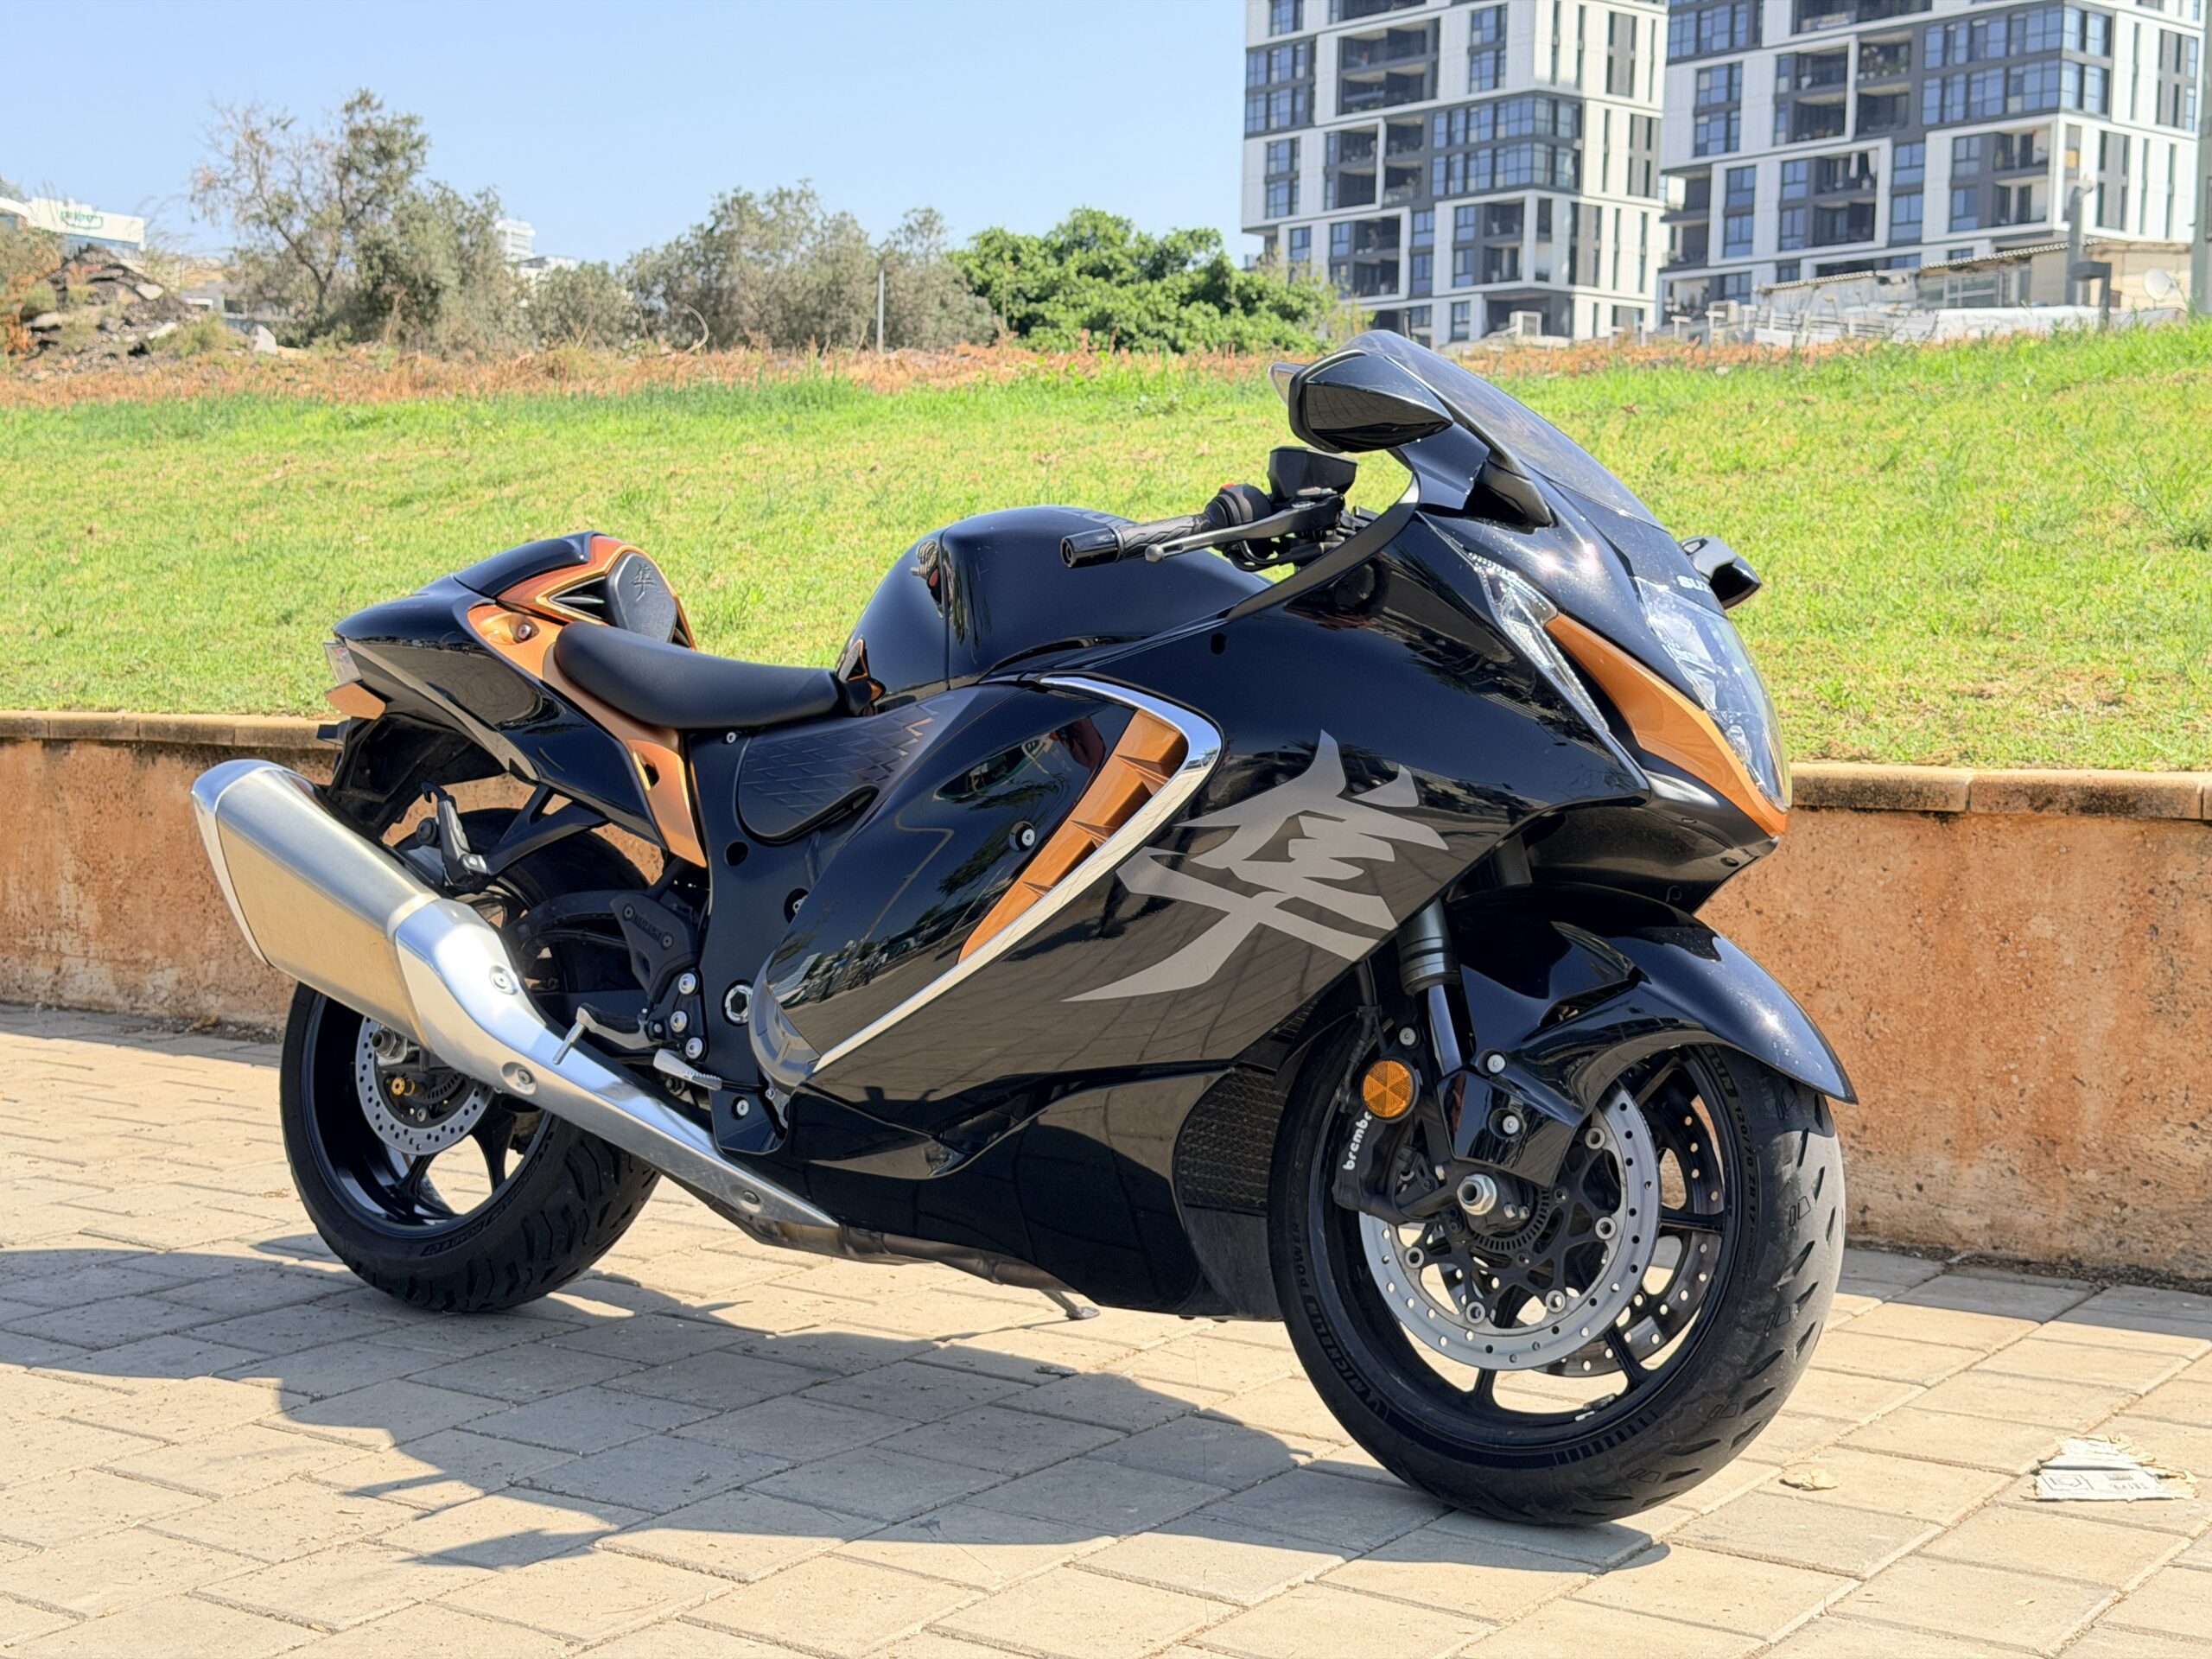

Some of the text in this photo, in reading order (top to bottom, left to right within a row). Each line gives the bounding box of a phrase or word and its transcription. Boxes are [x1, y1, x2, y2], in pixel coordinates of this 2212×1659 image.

[1735, 1105, 1755, 1167] 120/70
[1747, 1203, 1758, 1224] 17
[1291, 1222, 1310, 1288] POWER
[1306, 1302, 1367, 1395] MICHELIN
